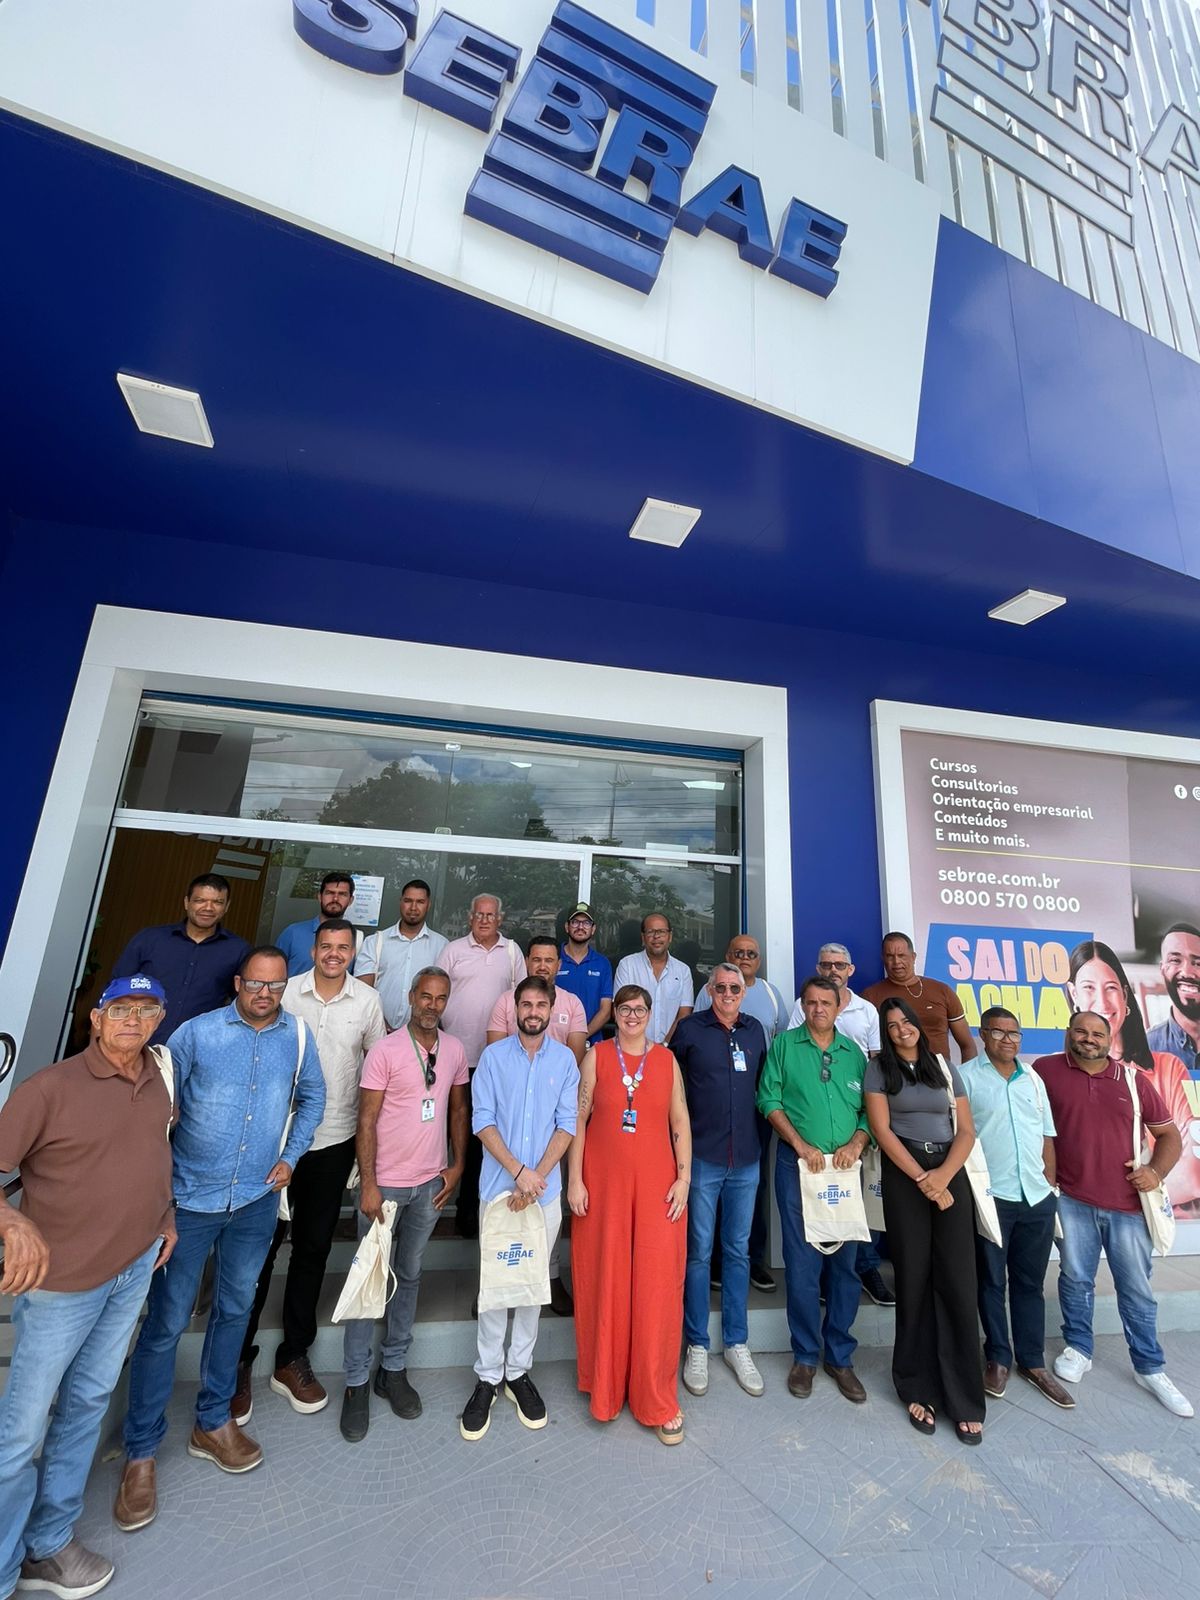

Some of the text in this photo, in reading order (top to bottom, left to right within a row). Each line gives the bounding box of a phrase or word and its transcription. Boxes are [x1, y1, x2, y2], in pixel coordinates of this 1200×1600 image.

[293, 0, 848, 299] SEBRAE
[930, 757, 977, 774] Cursos
[931, 775, 1019, 796] Consultorias
[932, 792, 1094, 820] Orientação empresarial
[934, 810, 1008, 829] Conteúdos
[935, 828, 1031, 848] E muito mais.
[938, 866, 1061, 889] sebrae.com.br
[940, 888, 1081, 913] 0800 570 0800
[947, 936, 1071, 985] SAI DO
[816, 1190, 852, 1200] SEBRAE
[496, 1249, 535, 1260] SEBRAE
